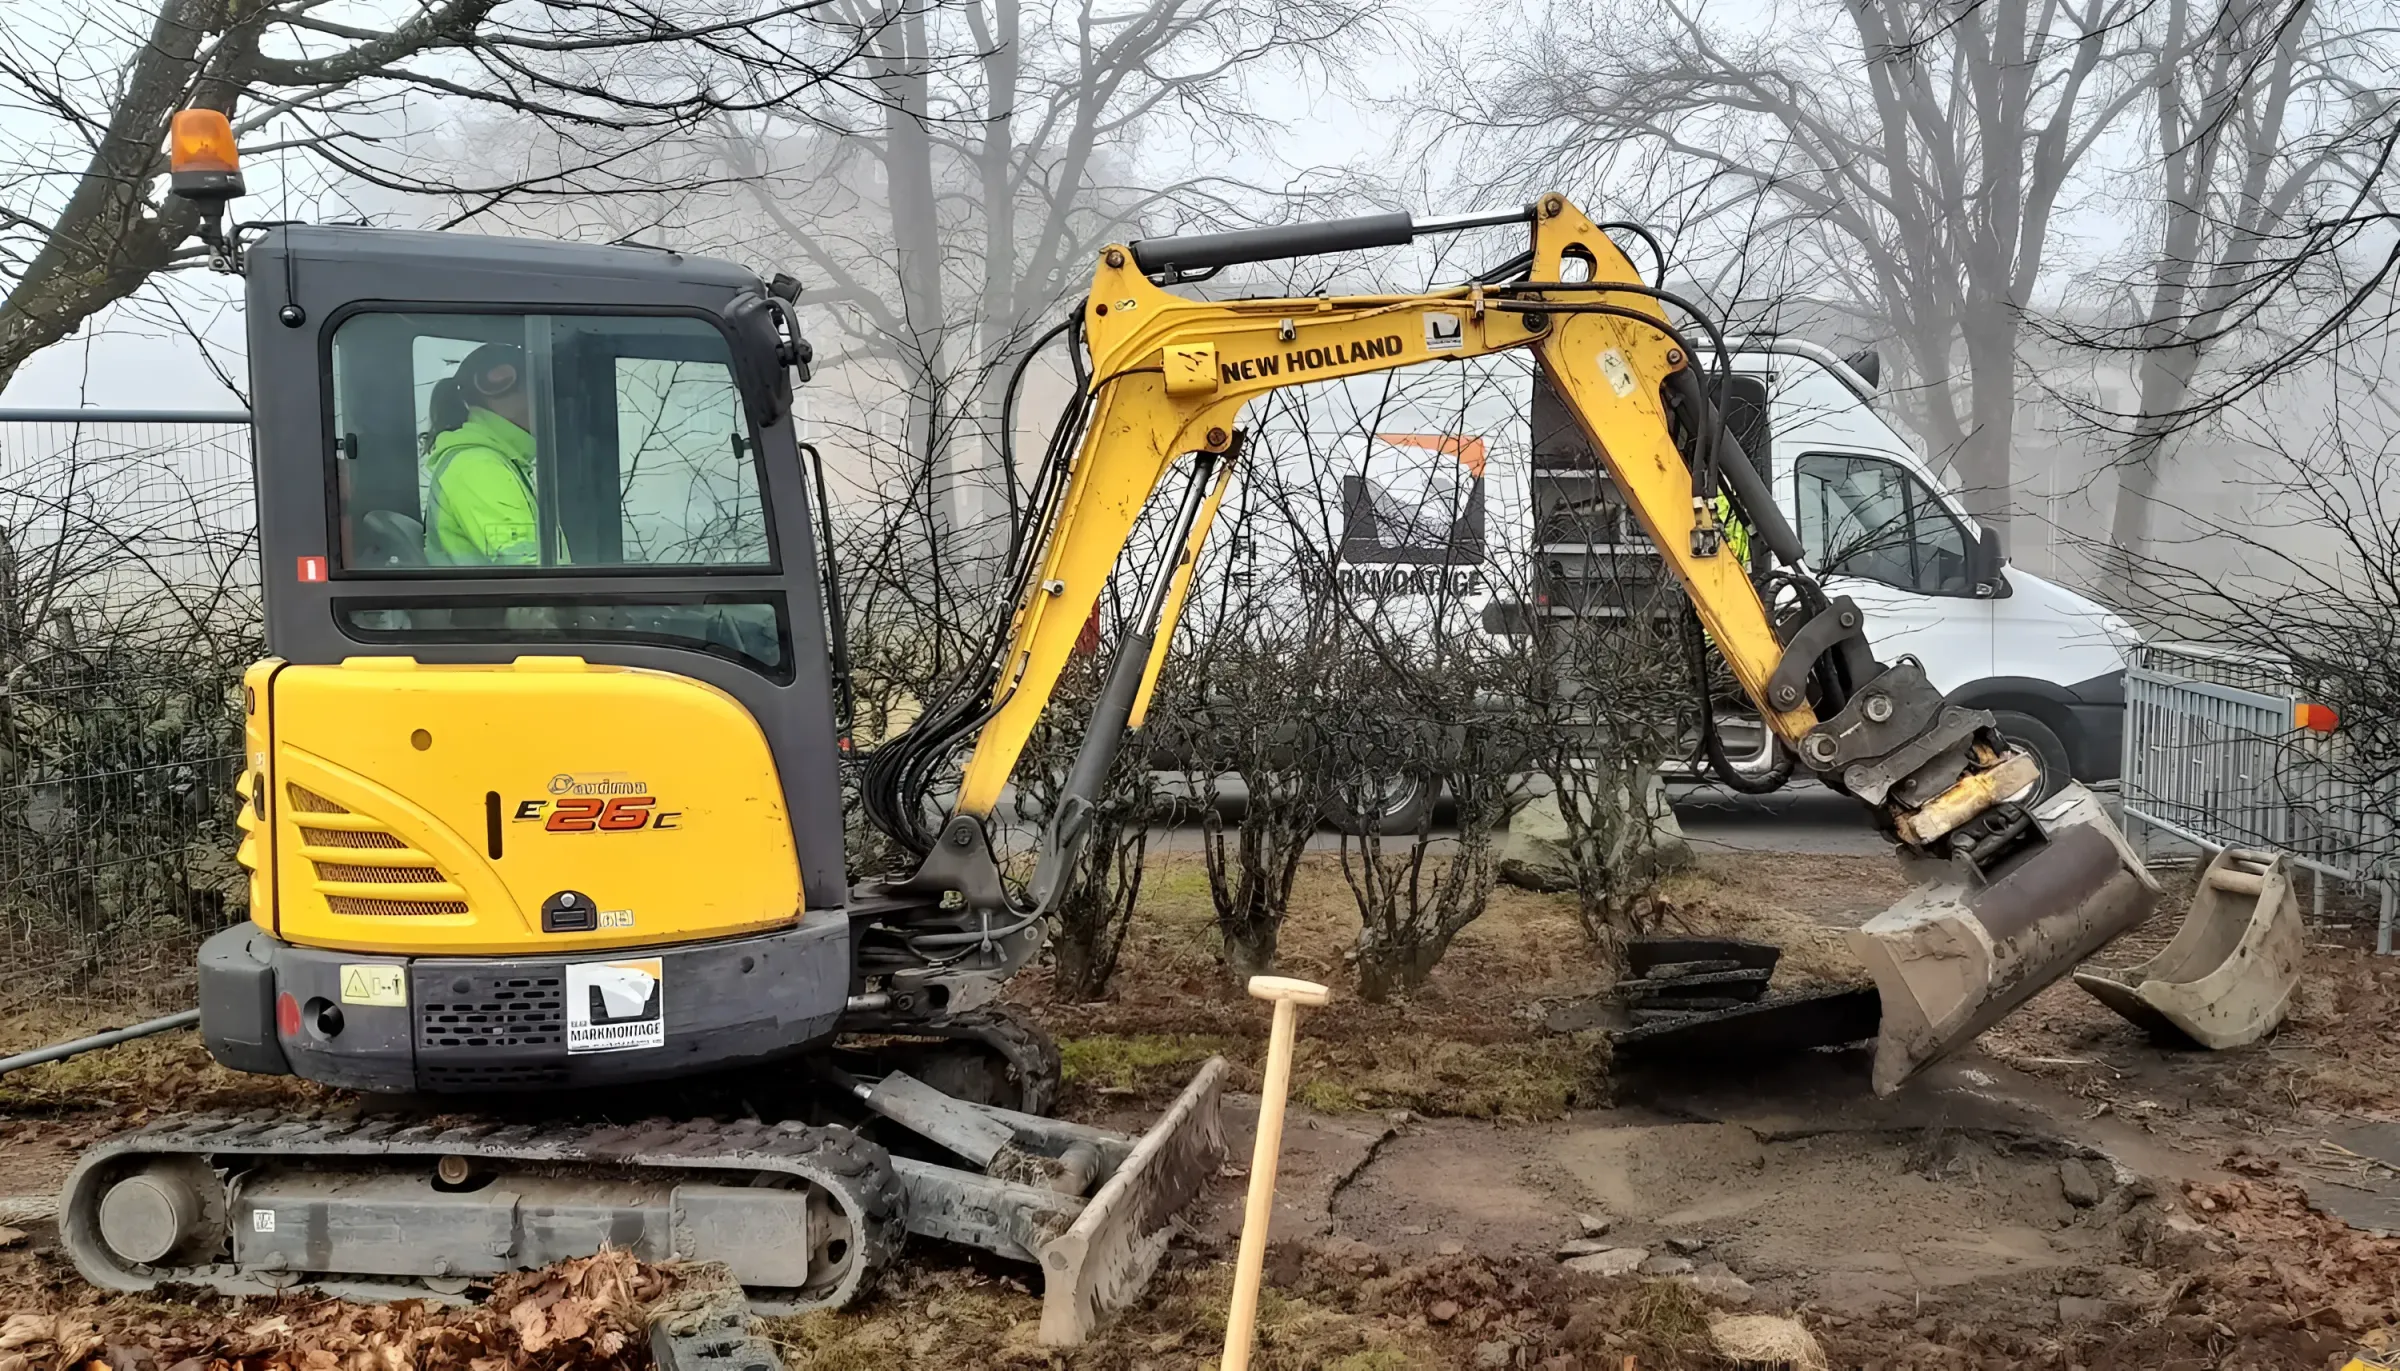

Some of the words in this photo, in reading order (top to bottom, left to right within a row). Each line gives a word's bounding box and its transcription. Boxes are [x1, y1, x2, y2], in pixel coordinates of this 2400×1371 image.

[1221, 354, 1279, 384] NEW
[1287, 335, 1403, 373] HOLLAND
[571, 1022, 661, 1042] MARKMONTAGE
